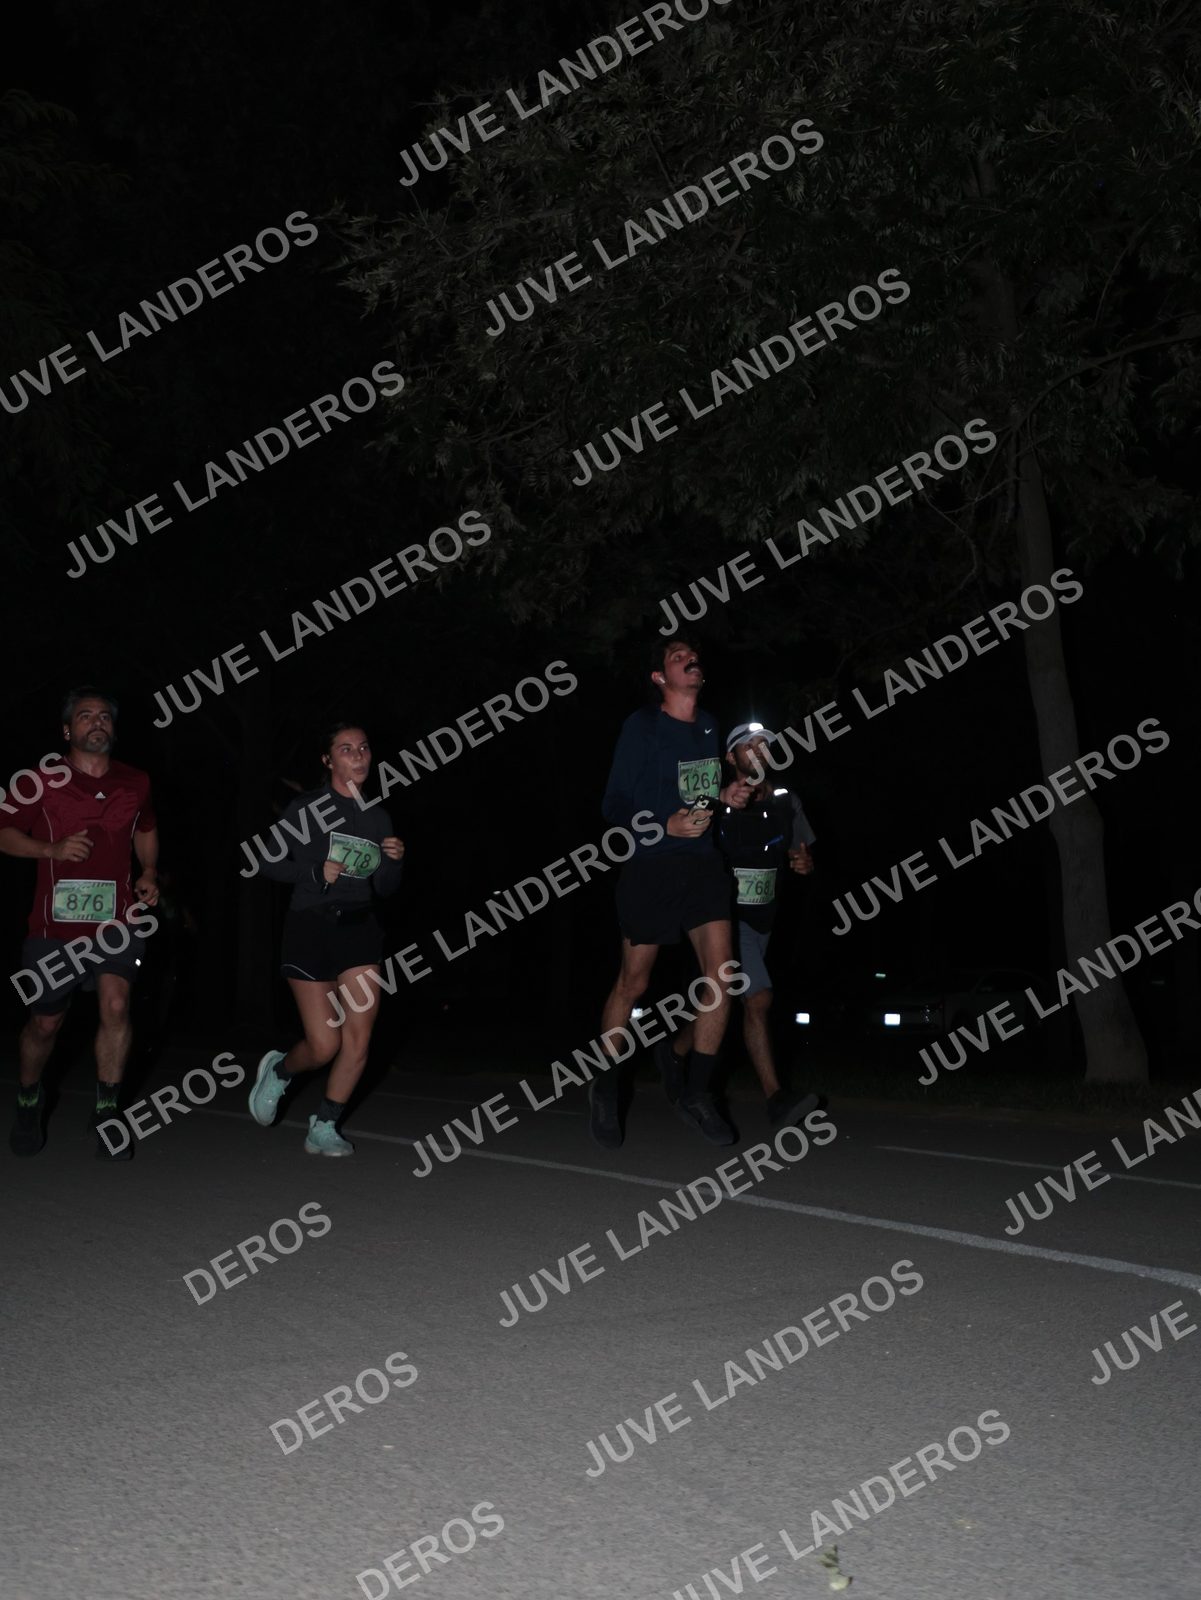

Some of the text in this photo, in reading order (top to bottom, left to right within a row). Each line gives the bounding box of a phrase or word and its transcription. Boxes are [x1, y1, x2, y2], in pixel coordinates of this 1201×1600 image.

[684, 771, 719, 792] 1264
[342, 847, 372, 869] 778
[745, 880, 769, 896] 768
[66, 893, 104, 912] 876
